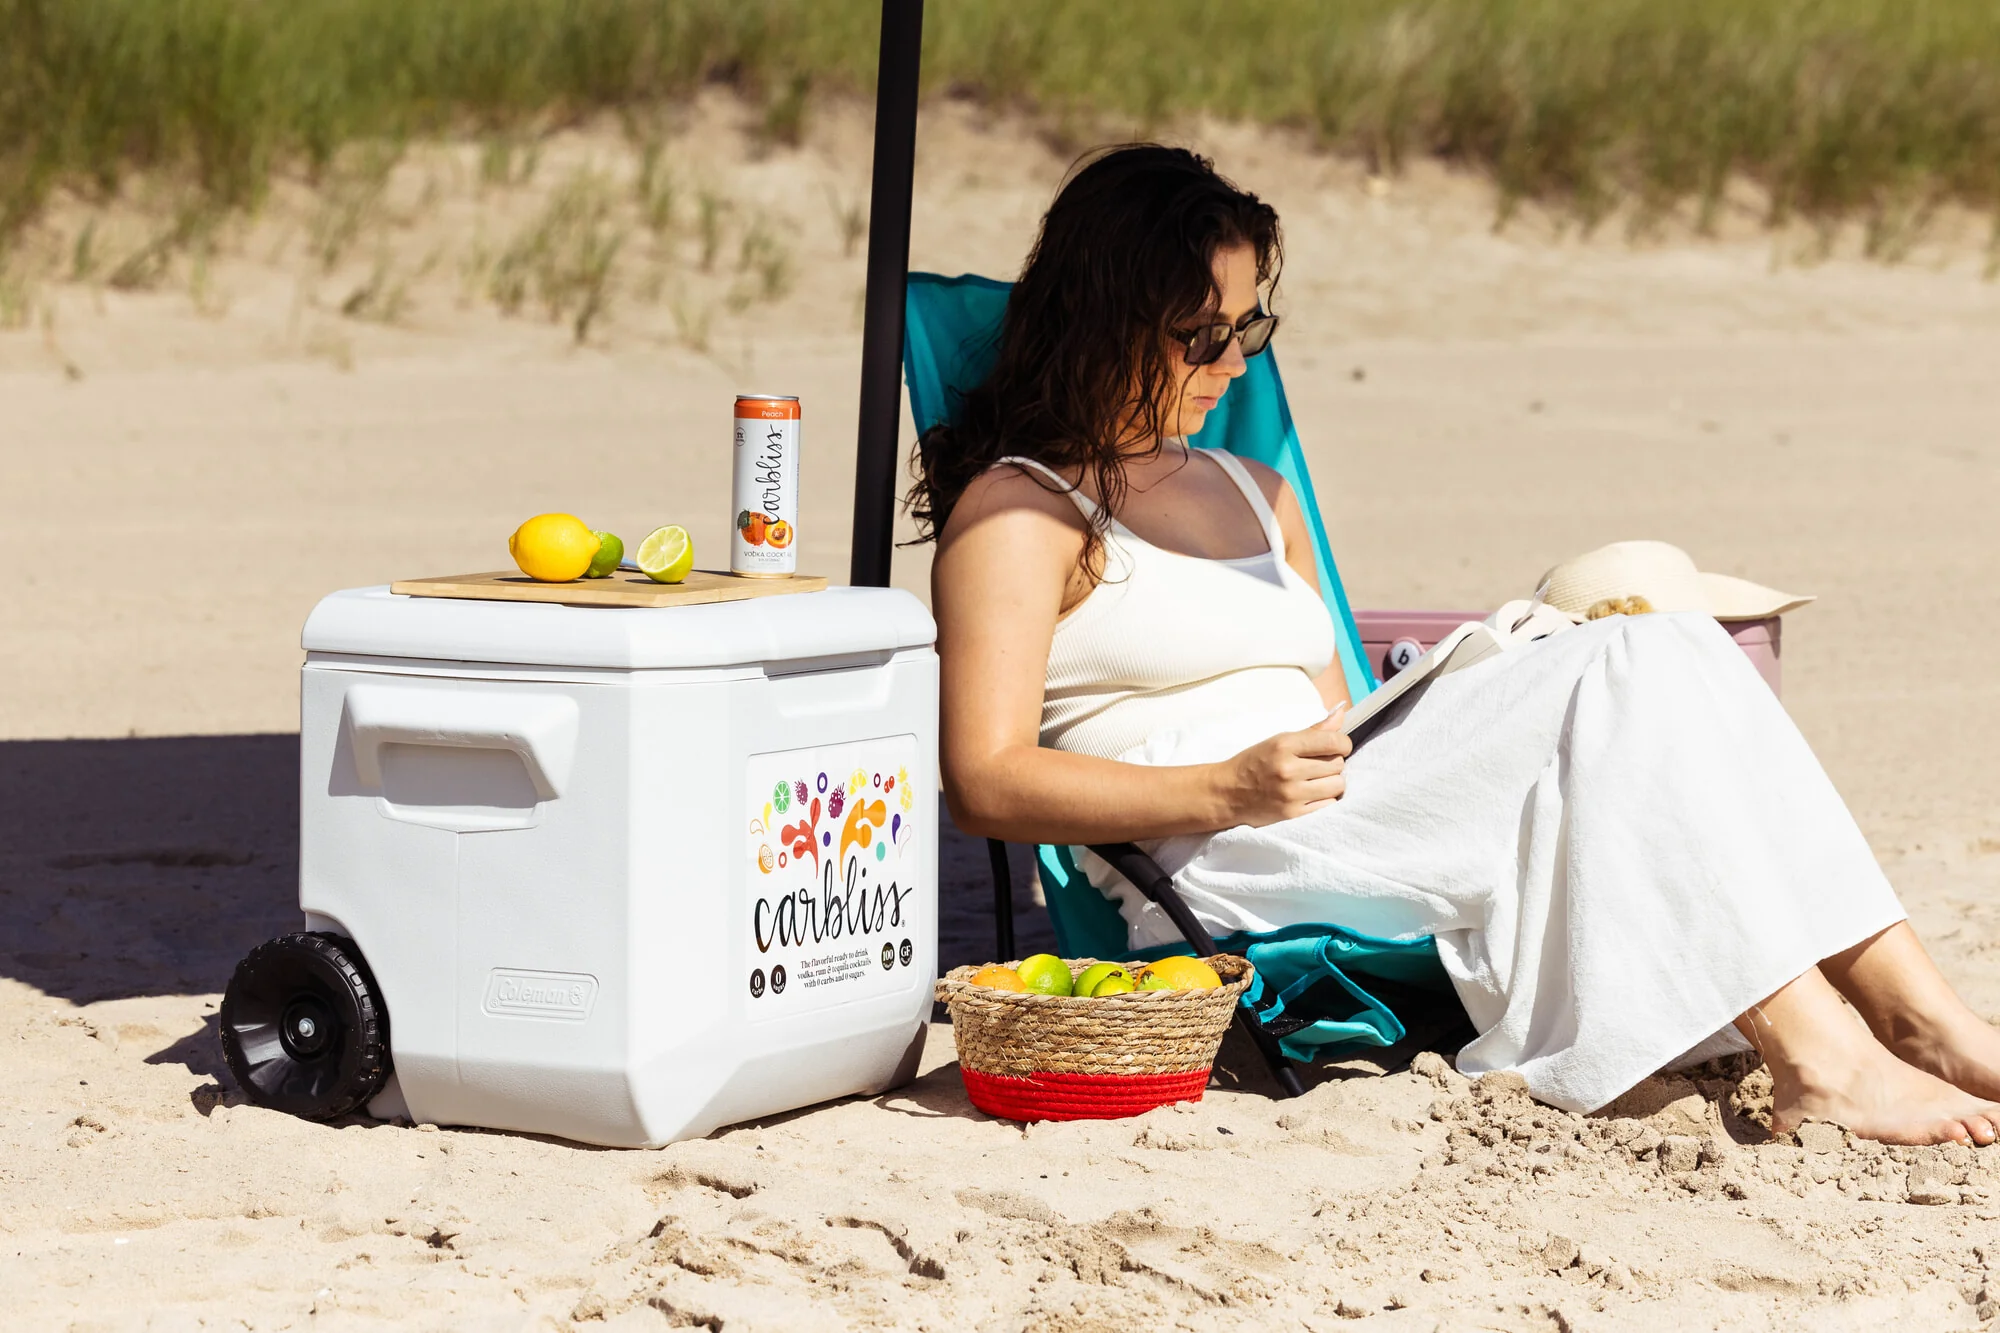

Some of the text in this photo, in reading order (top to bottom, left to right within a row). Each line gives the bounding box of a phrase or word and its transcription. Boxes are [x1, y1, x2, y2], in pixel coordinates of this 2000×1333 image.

[755, 424, 782, 526] carbliss
[753, 855, 913, 954] carbliss
[883, 949, 894, 961] 100
[900, 944, 911, 957] GF
[801, 961, 811, 969] The
[811, 955, 834, 967] flavorful
[834, 952, 848, 962] ready
[855, 948, 868, 958] drink
[827, 966, 831, 974] &
[832, 961, 849, 974] tequila
[850, 958, 872, 969] cocktails
[755, 975, 760, 988] 0
[775, 971, 781, 984] 0
[804, 979, 816, 988] with
[821, 976, 834, 985] carbs
[835, 973, 844, 982] and
[498, 978, 566, 1005] Coleman
